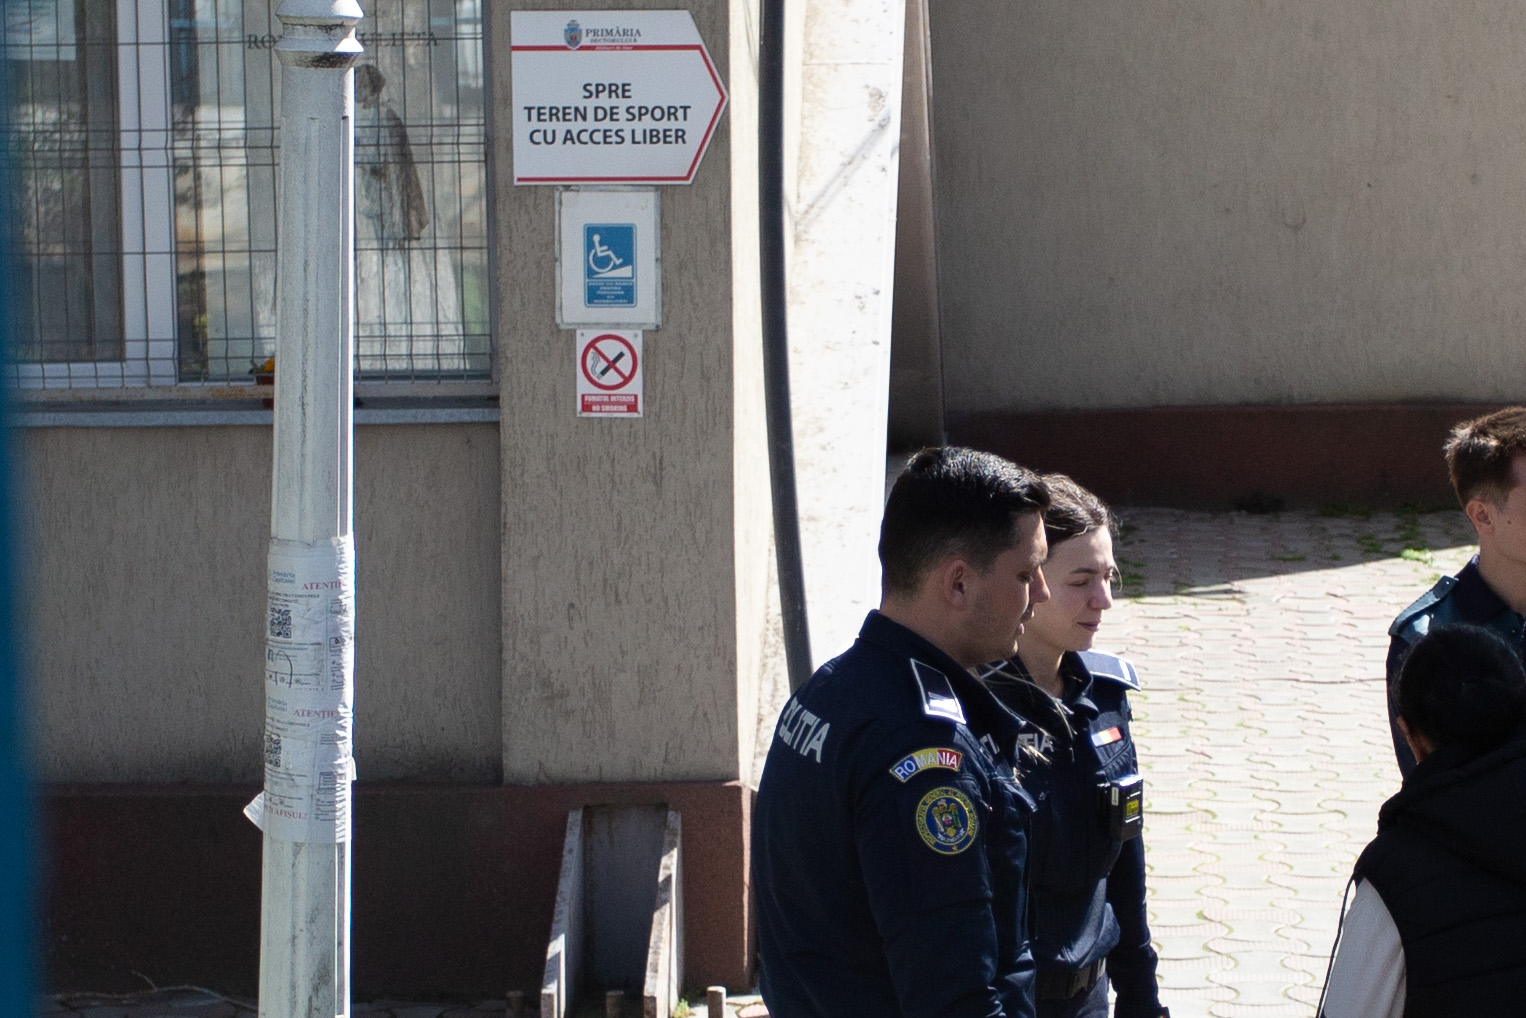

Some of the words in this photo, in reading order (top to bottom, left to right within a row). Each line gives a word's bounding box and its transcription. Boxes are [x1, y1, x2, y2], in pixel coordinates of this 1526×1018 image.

[585, 26, 642, 37] PRIMĂRIA
[582, 83, 632, 99] SPRE
[523, 106, 588, 122] TEREN
[593, 106, 620, 122] DE
[625, 105, 691, 122] SPORT
[529, 129, 556, 145] CU
[562, 129, 625, 145] ACCES
[631, 129, 687, 145] LIBER
